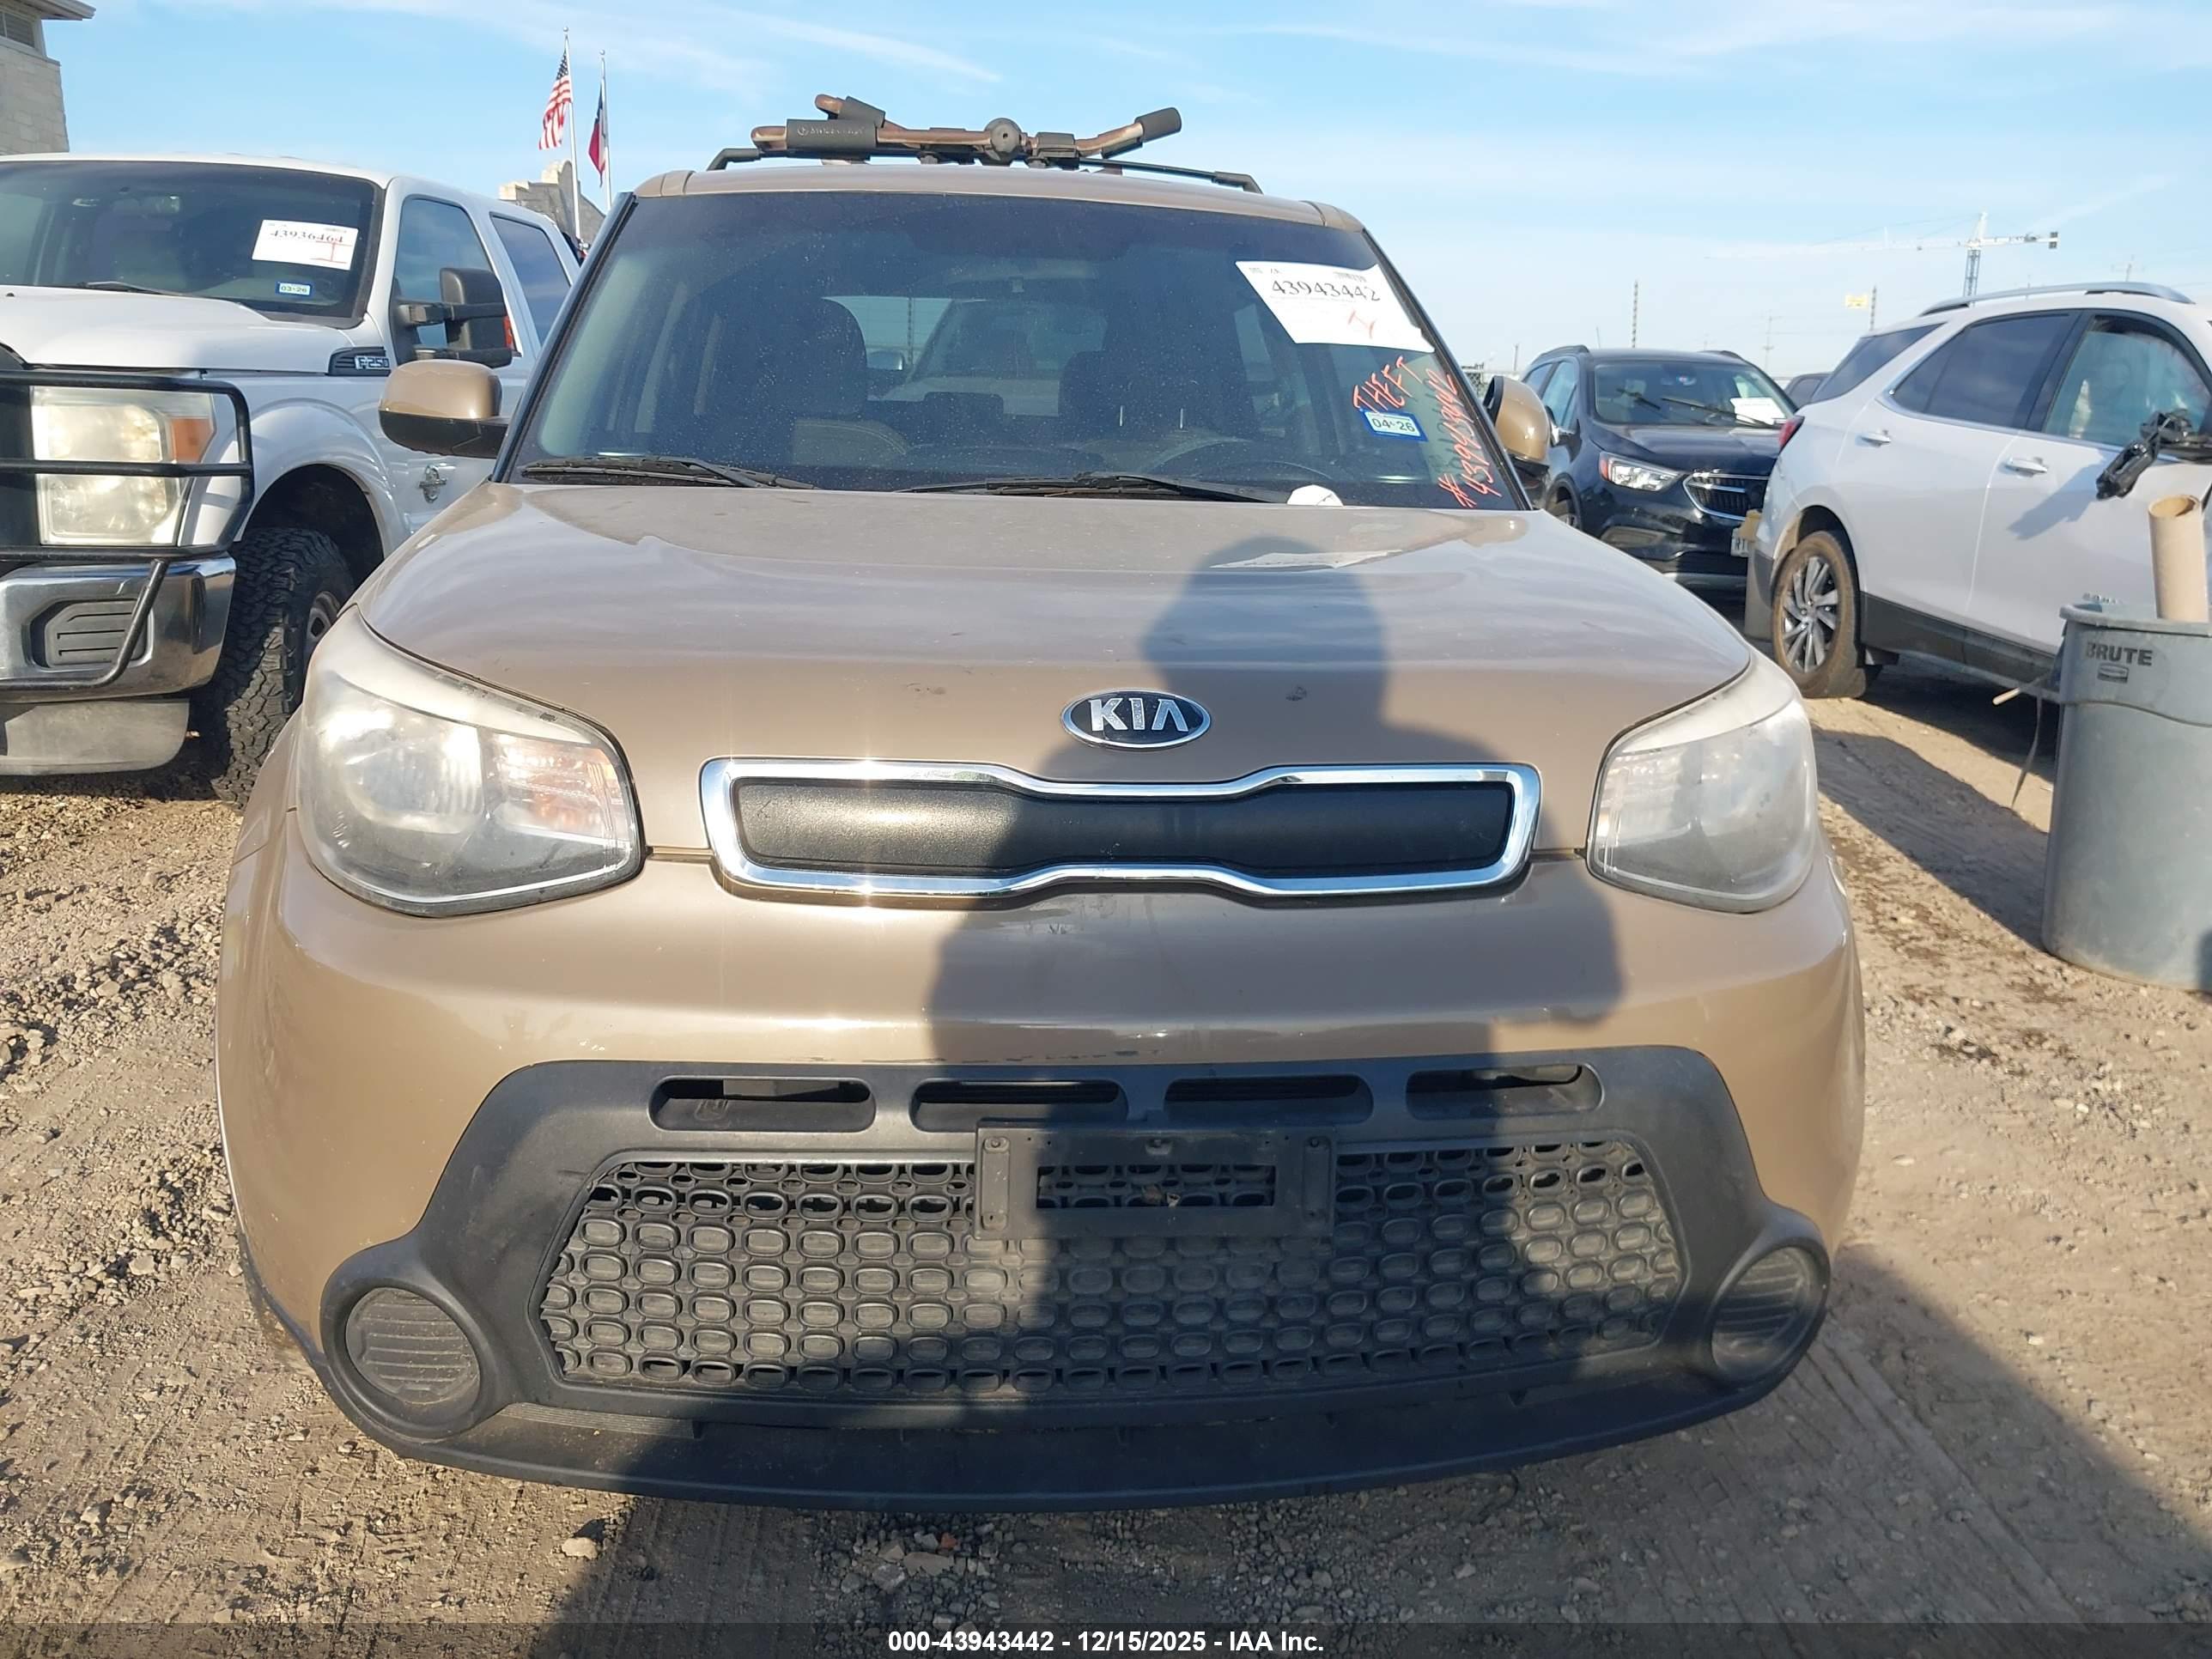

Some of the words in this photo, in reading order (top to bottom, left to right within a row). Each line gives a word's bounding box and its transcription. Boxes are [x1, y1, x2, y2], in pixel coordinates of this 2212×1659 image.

[1272, 279, 1381, 301] 43943442
[2086, 641, 2154, 667] BRUTE
[1088, 697, 1189, 732] KIA
